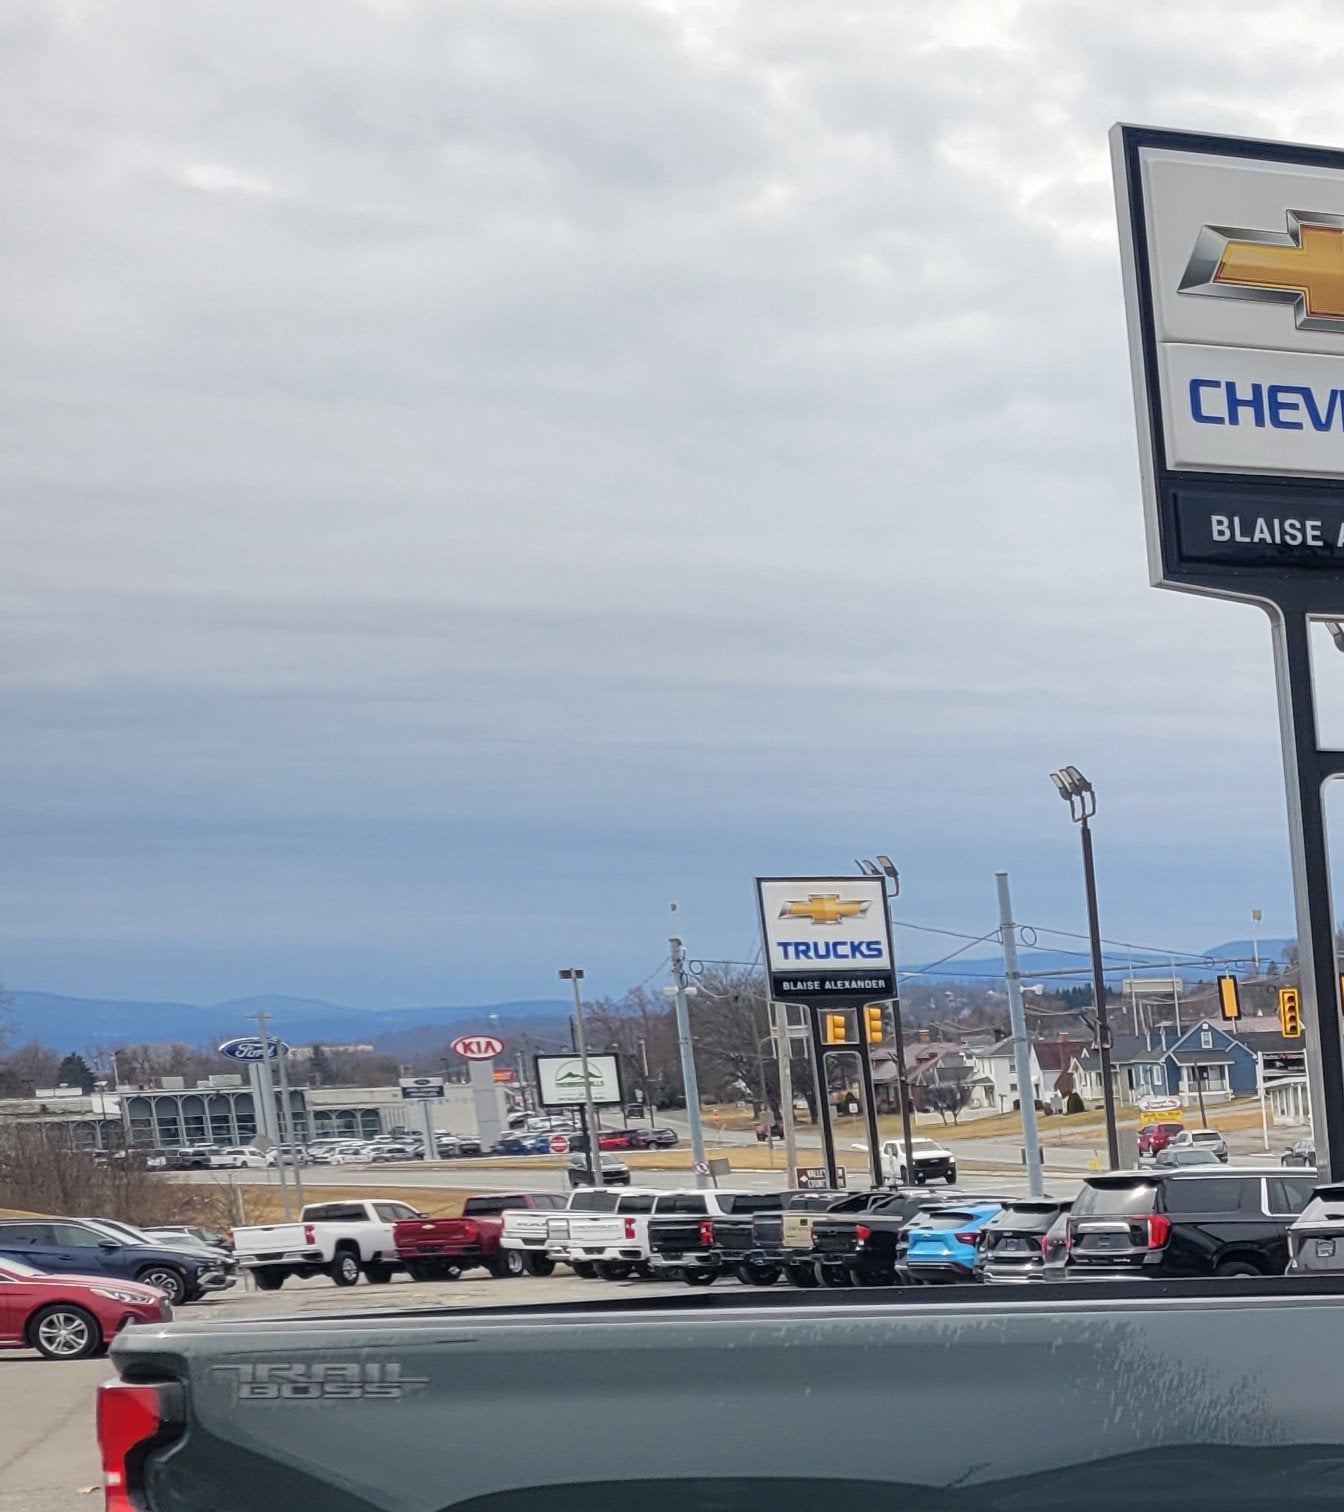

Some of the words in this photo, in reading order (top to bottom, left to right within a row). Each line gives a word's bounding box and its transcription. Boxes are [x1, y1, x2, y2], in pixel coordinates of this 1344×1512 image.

[1211, 514, 1324, 547] BLAISE
[777, 940, 883, 960] TRUCKS
[783, 981, 821, 990] BLAISE
[824, 979, 886, 990] ALEXANDER
[462, 1041, 498, 1054] KIA
[210, 1363, 431, 1383] TRAIL
[237, 1382, 401, 1400] BOSS
